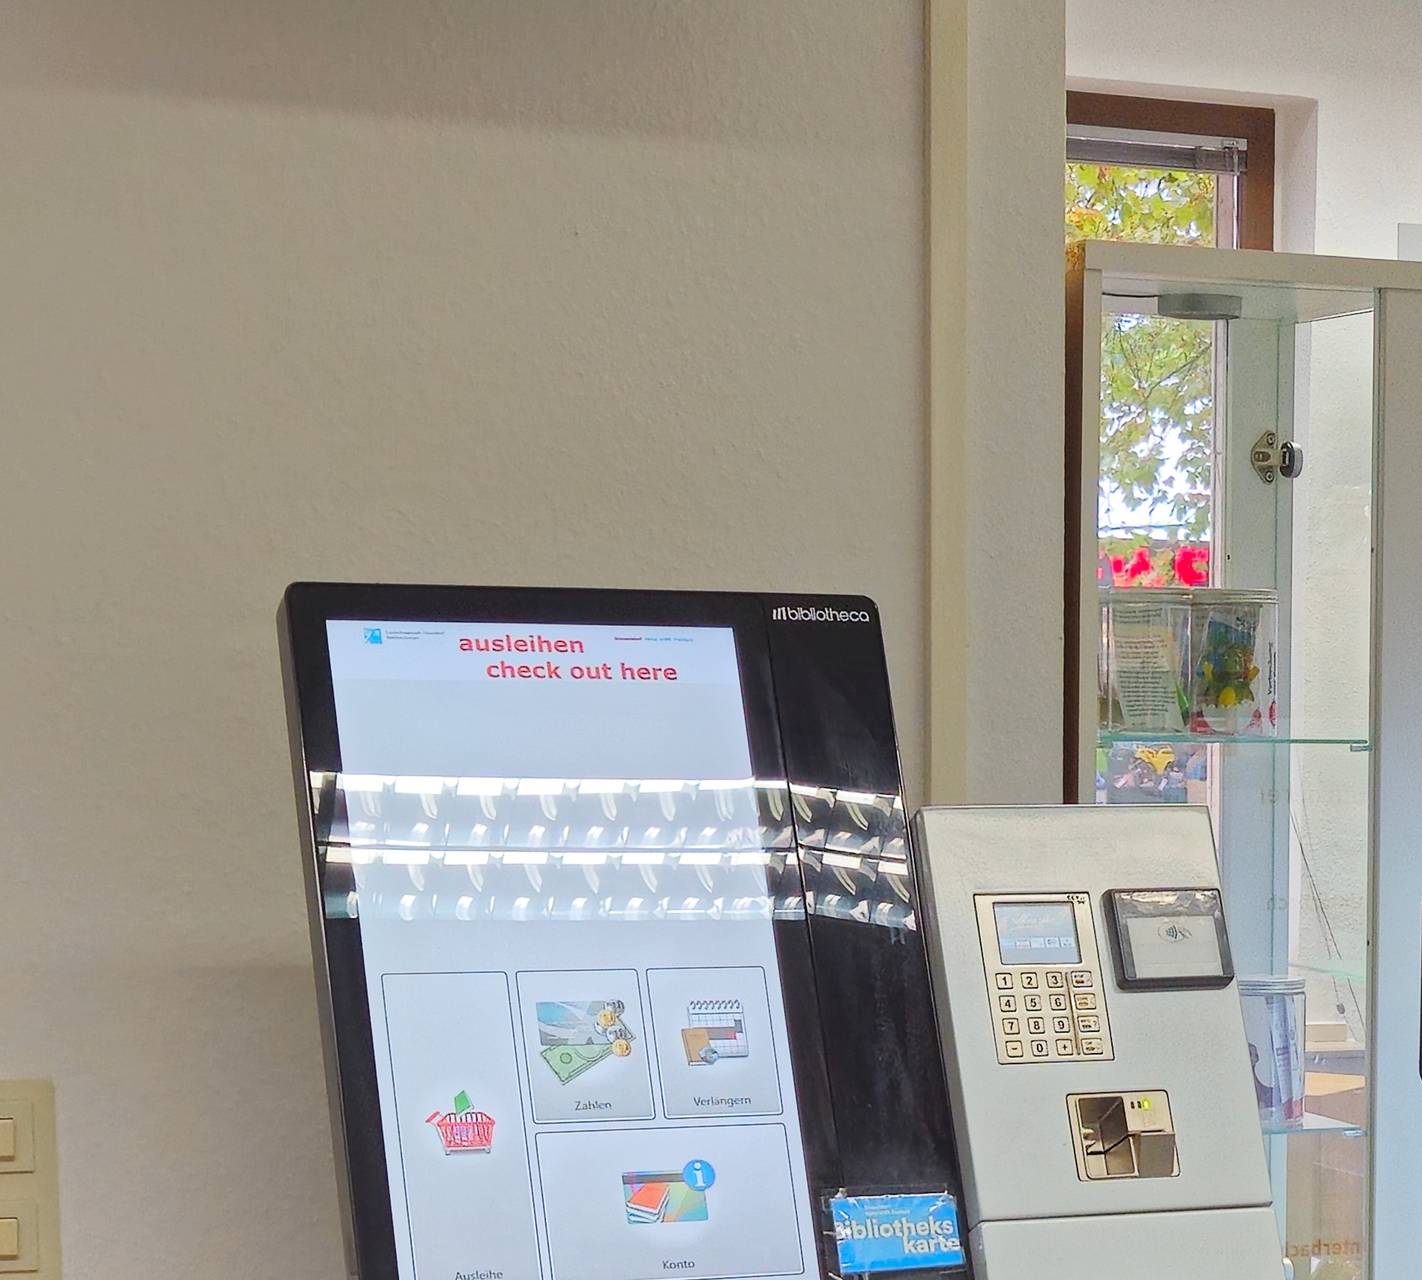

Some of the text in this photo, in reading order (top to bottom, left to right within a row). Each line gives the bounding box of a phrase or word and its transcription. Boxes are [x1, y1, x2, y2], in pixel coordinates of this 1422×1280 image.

[786, 606, 870, 622] bibliotheca
[459, 634, 585, 653] ausleihen
[486, 661, 678, 681] check out here
[1026, 976, 1033, 986] 2
[1051, 975, 1058, 985] 3
[1004, 997, 1062, 1008] 4 5 6
[1008, 1020, 1065, 1031] 7 8 9
[1036, 1043, 1044, 1054] 0
[575, 1100, 612, 1111] Zahlen
[693, 1095, 752, 1108] Verlängern
[902, 1234, 961, 1255] karte
[662, 1259, 696, 1270] Konto
[454, 1269, 504, 1280] Ausleihe
